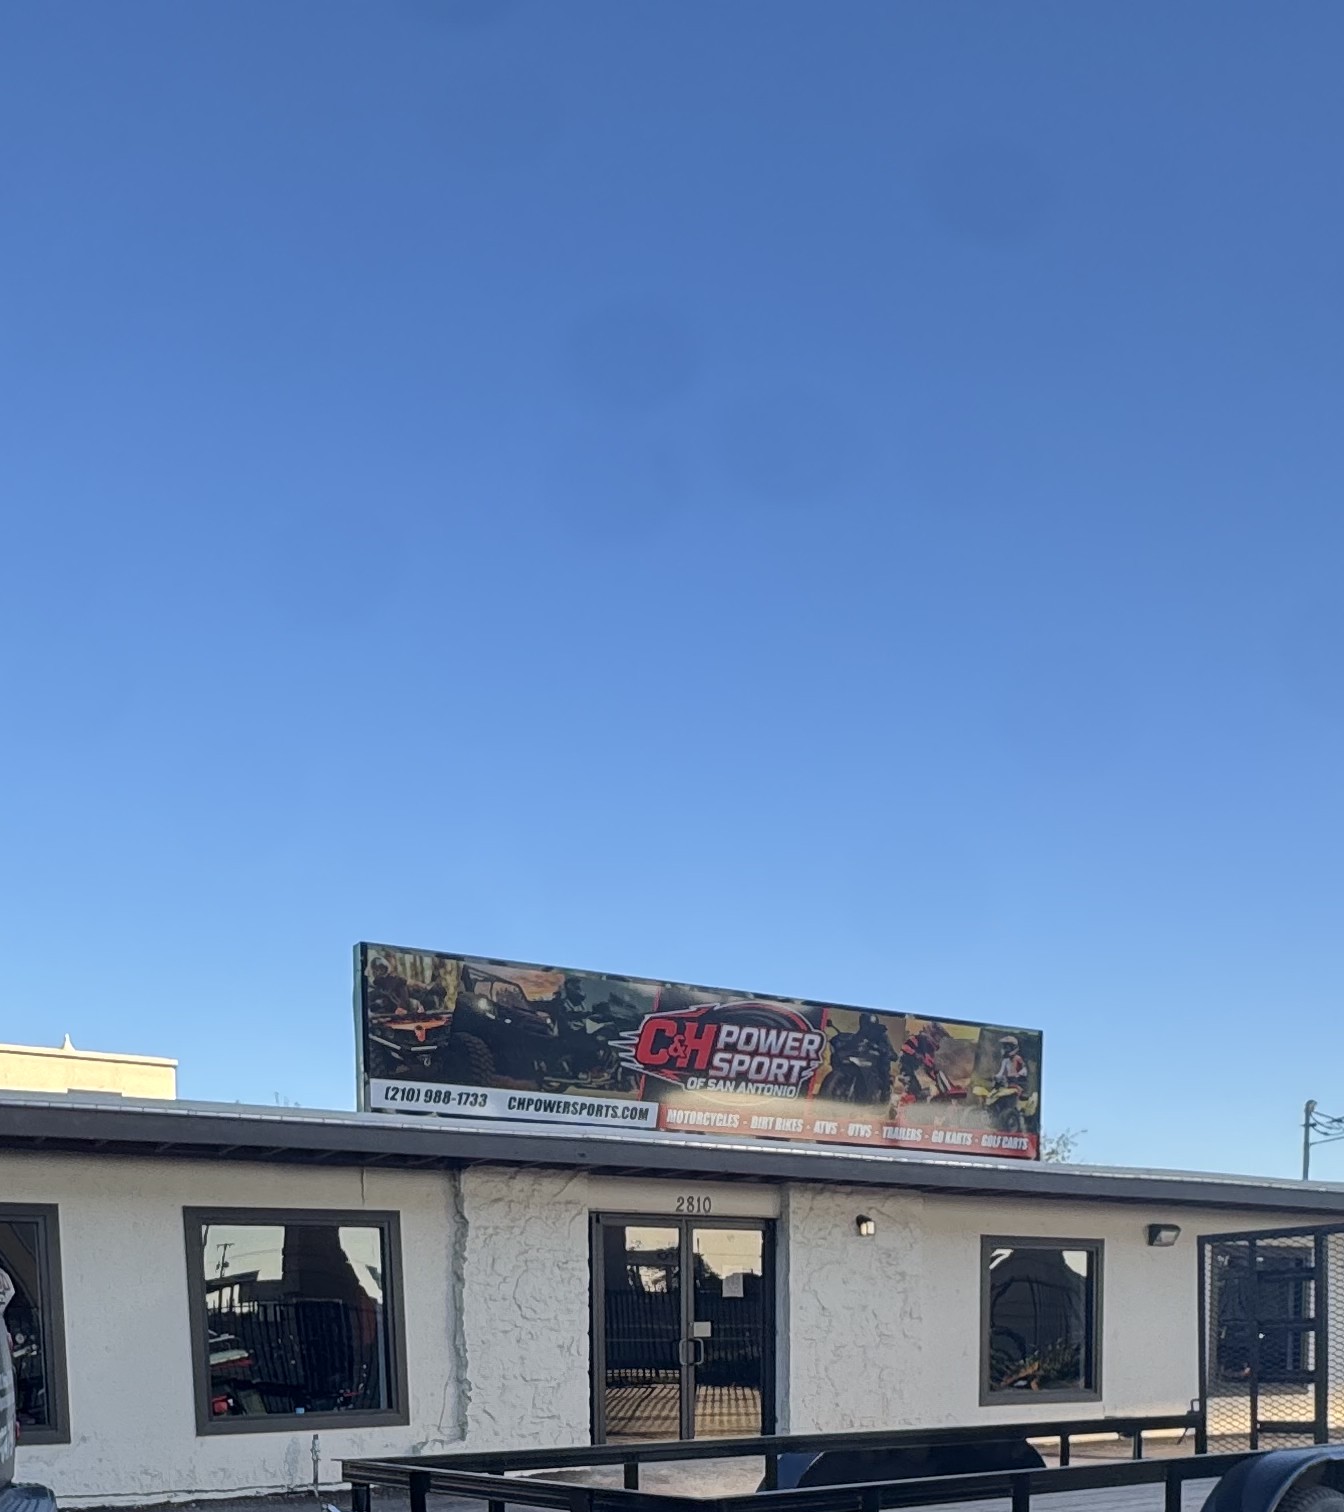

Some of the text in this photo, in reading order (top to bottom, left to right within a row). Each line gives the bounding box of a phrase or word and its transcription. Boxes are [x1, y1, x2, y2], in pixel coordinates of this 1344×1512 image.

[636, 1018, 718, 1069] C&H
[716, 1024, 821, 1059] POWER
[385, 1086, 650, 1121] (210) 988-1733 CHPOWERSPORTS.COM
[686, 1077, 797, 1098] OF SAN ANTONIO
[666, 1109, 740, 1128] MOTORCYCLES
[750, 1115, 774, 1130] DIRT
[775, 1117, 804, 1132] BIKES
[812, 1120, 839, 1135] ATVS
[882, 1126, 924, 1142] TRAILERS
[931, 1130, 945, 1144] GO
[945, 1132, 973, 1146] KARTS
[980, 1134, 1002, 1149] GOLF
[1001, 1136, 1030, 1151] CARTS
[675, 1195, 712, 1213] 2810
